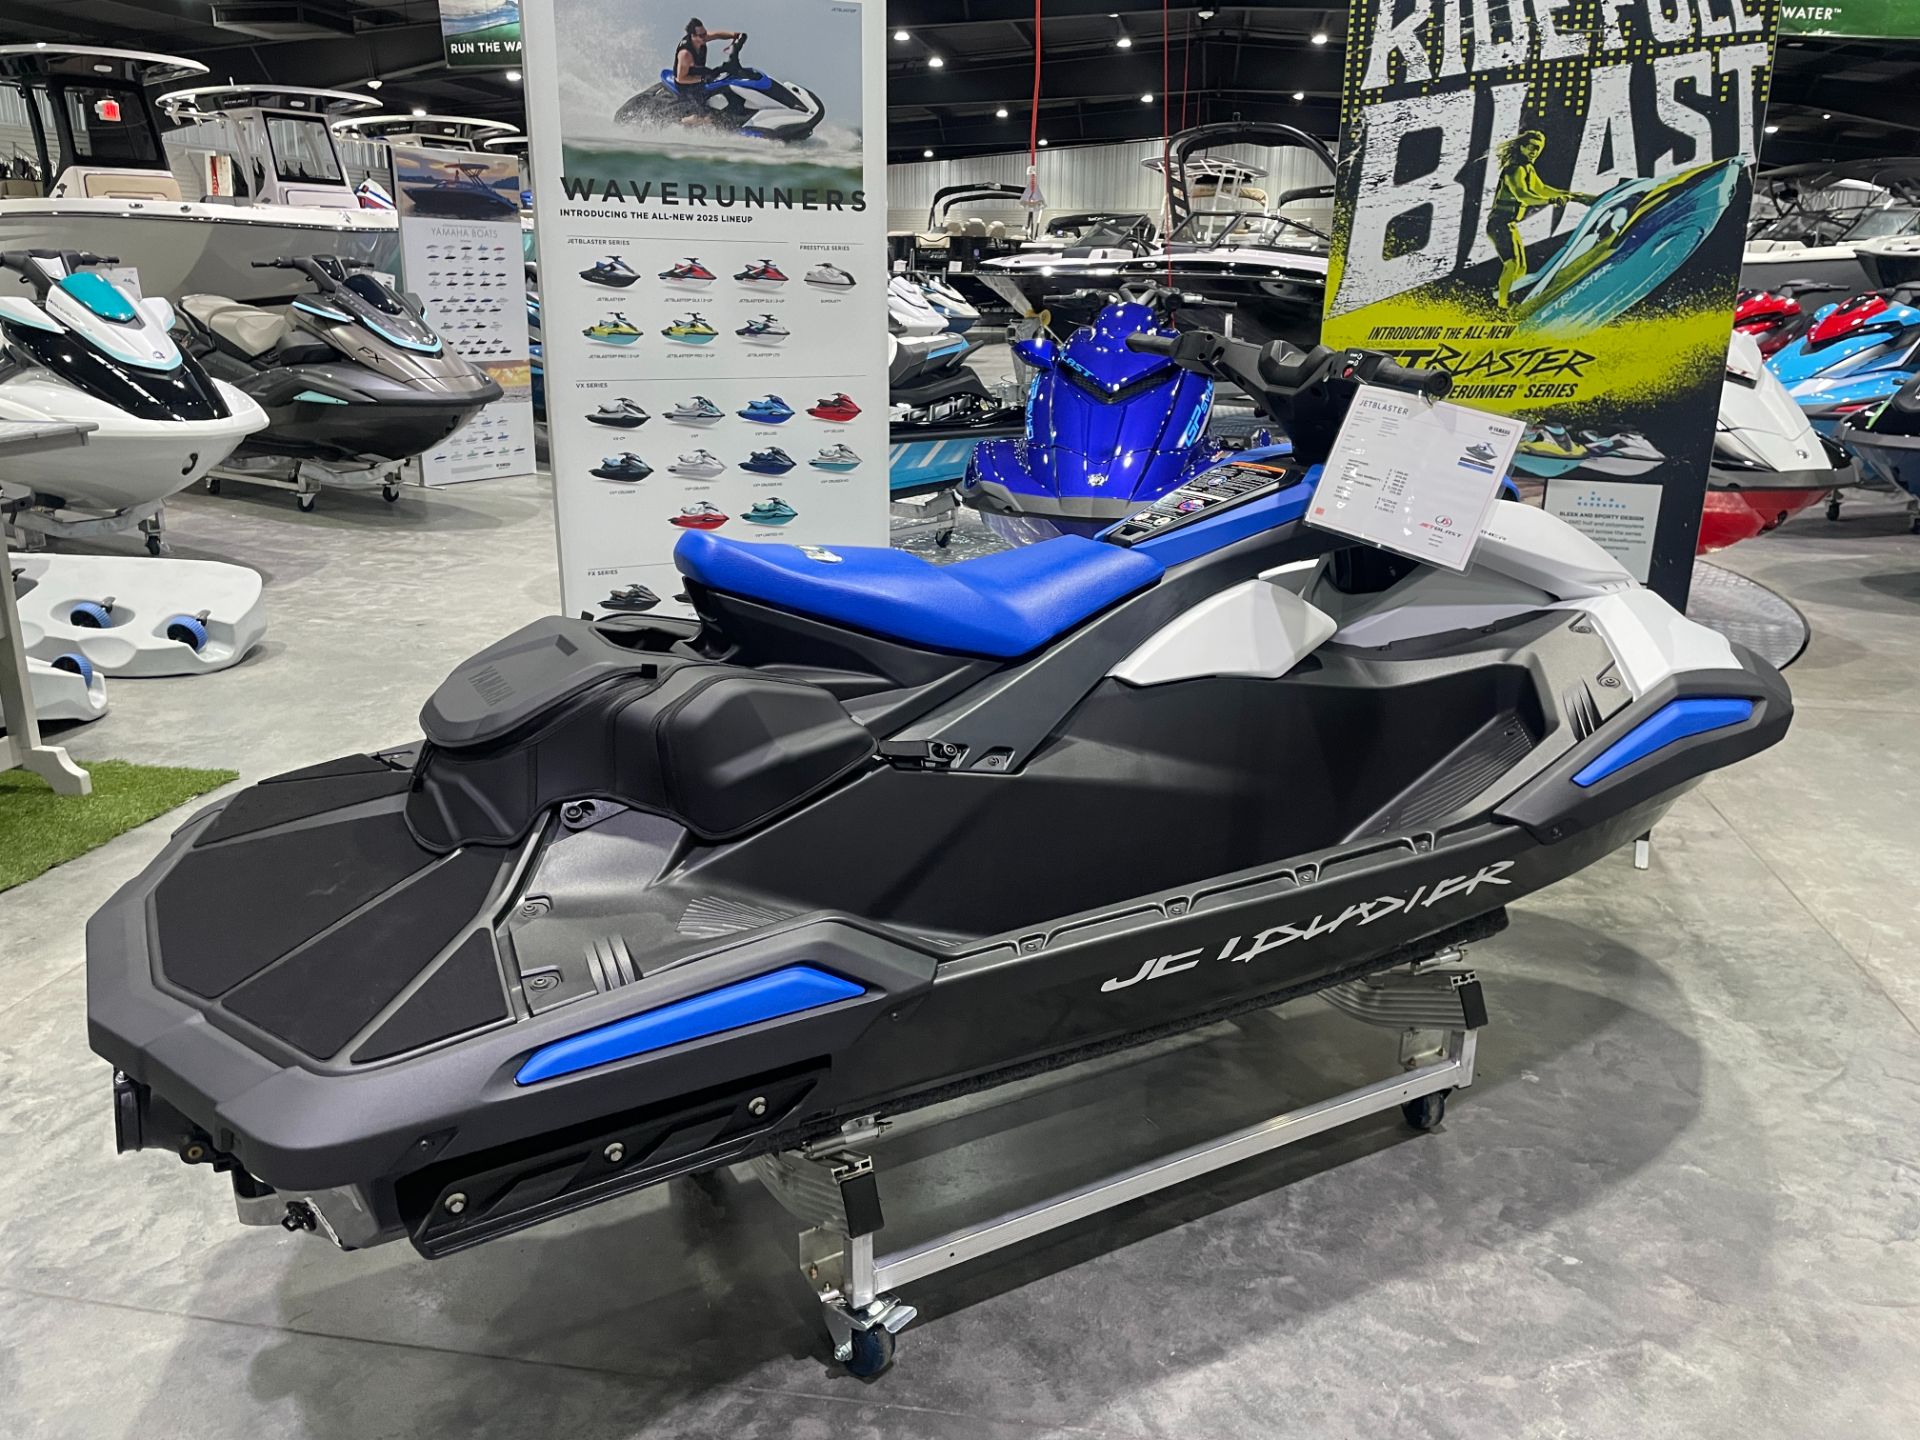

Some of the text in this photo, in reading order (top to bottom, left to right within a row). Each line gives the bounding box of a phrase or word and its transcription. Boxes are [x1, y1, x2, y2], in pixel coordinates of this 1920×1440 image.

[450, 43, 474, 54] RUN
[477, 41, 501, 53] THE
[1325, 42, 1770, 319] BLAST
[560, 176, 867, 212] WAVERUNNERS
[559, 209, 753, 223] INTRODUCING THE ALL-NEW 2025 LINEUP
[431, 227, 498, 238] YAMAHA BOATS
[567, 238, 607, 246] JETBLASTER
[1367, 325, 1517, 340] INTRODUCING THE ALL-NEW
[357, 346, 386, 364] FX
[1383, 342, 1597, 378] TBLASTER
[1523, 382, 1578, 398] SERIES
[1359, 399, 1409, 416] JETBLASTER
